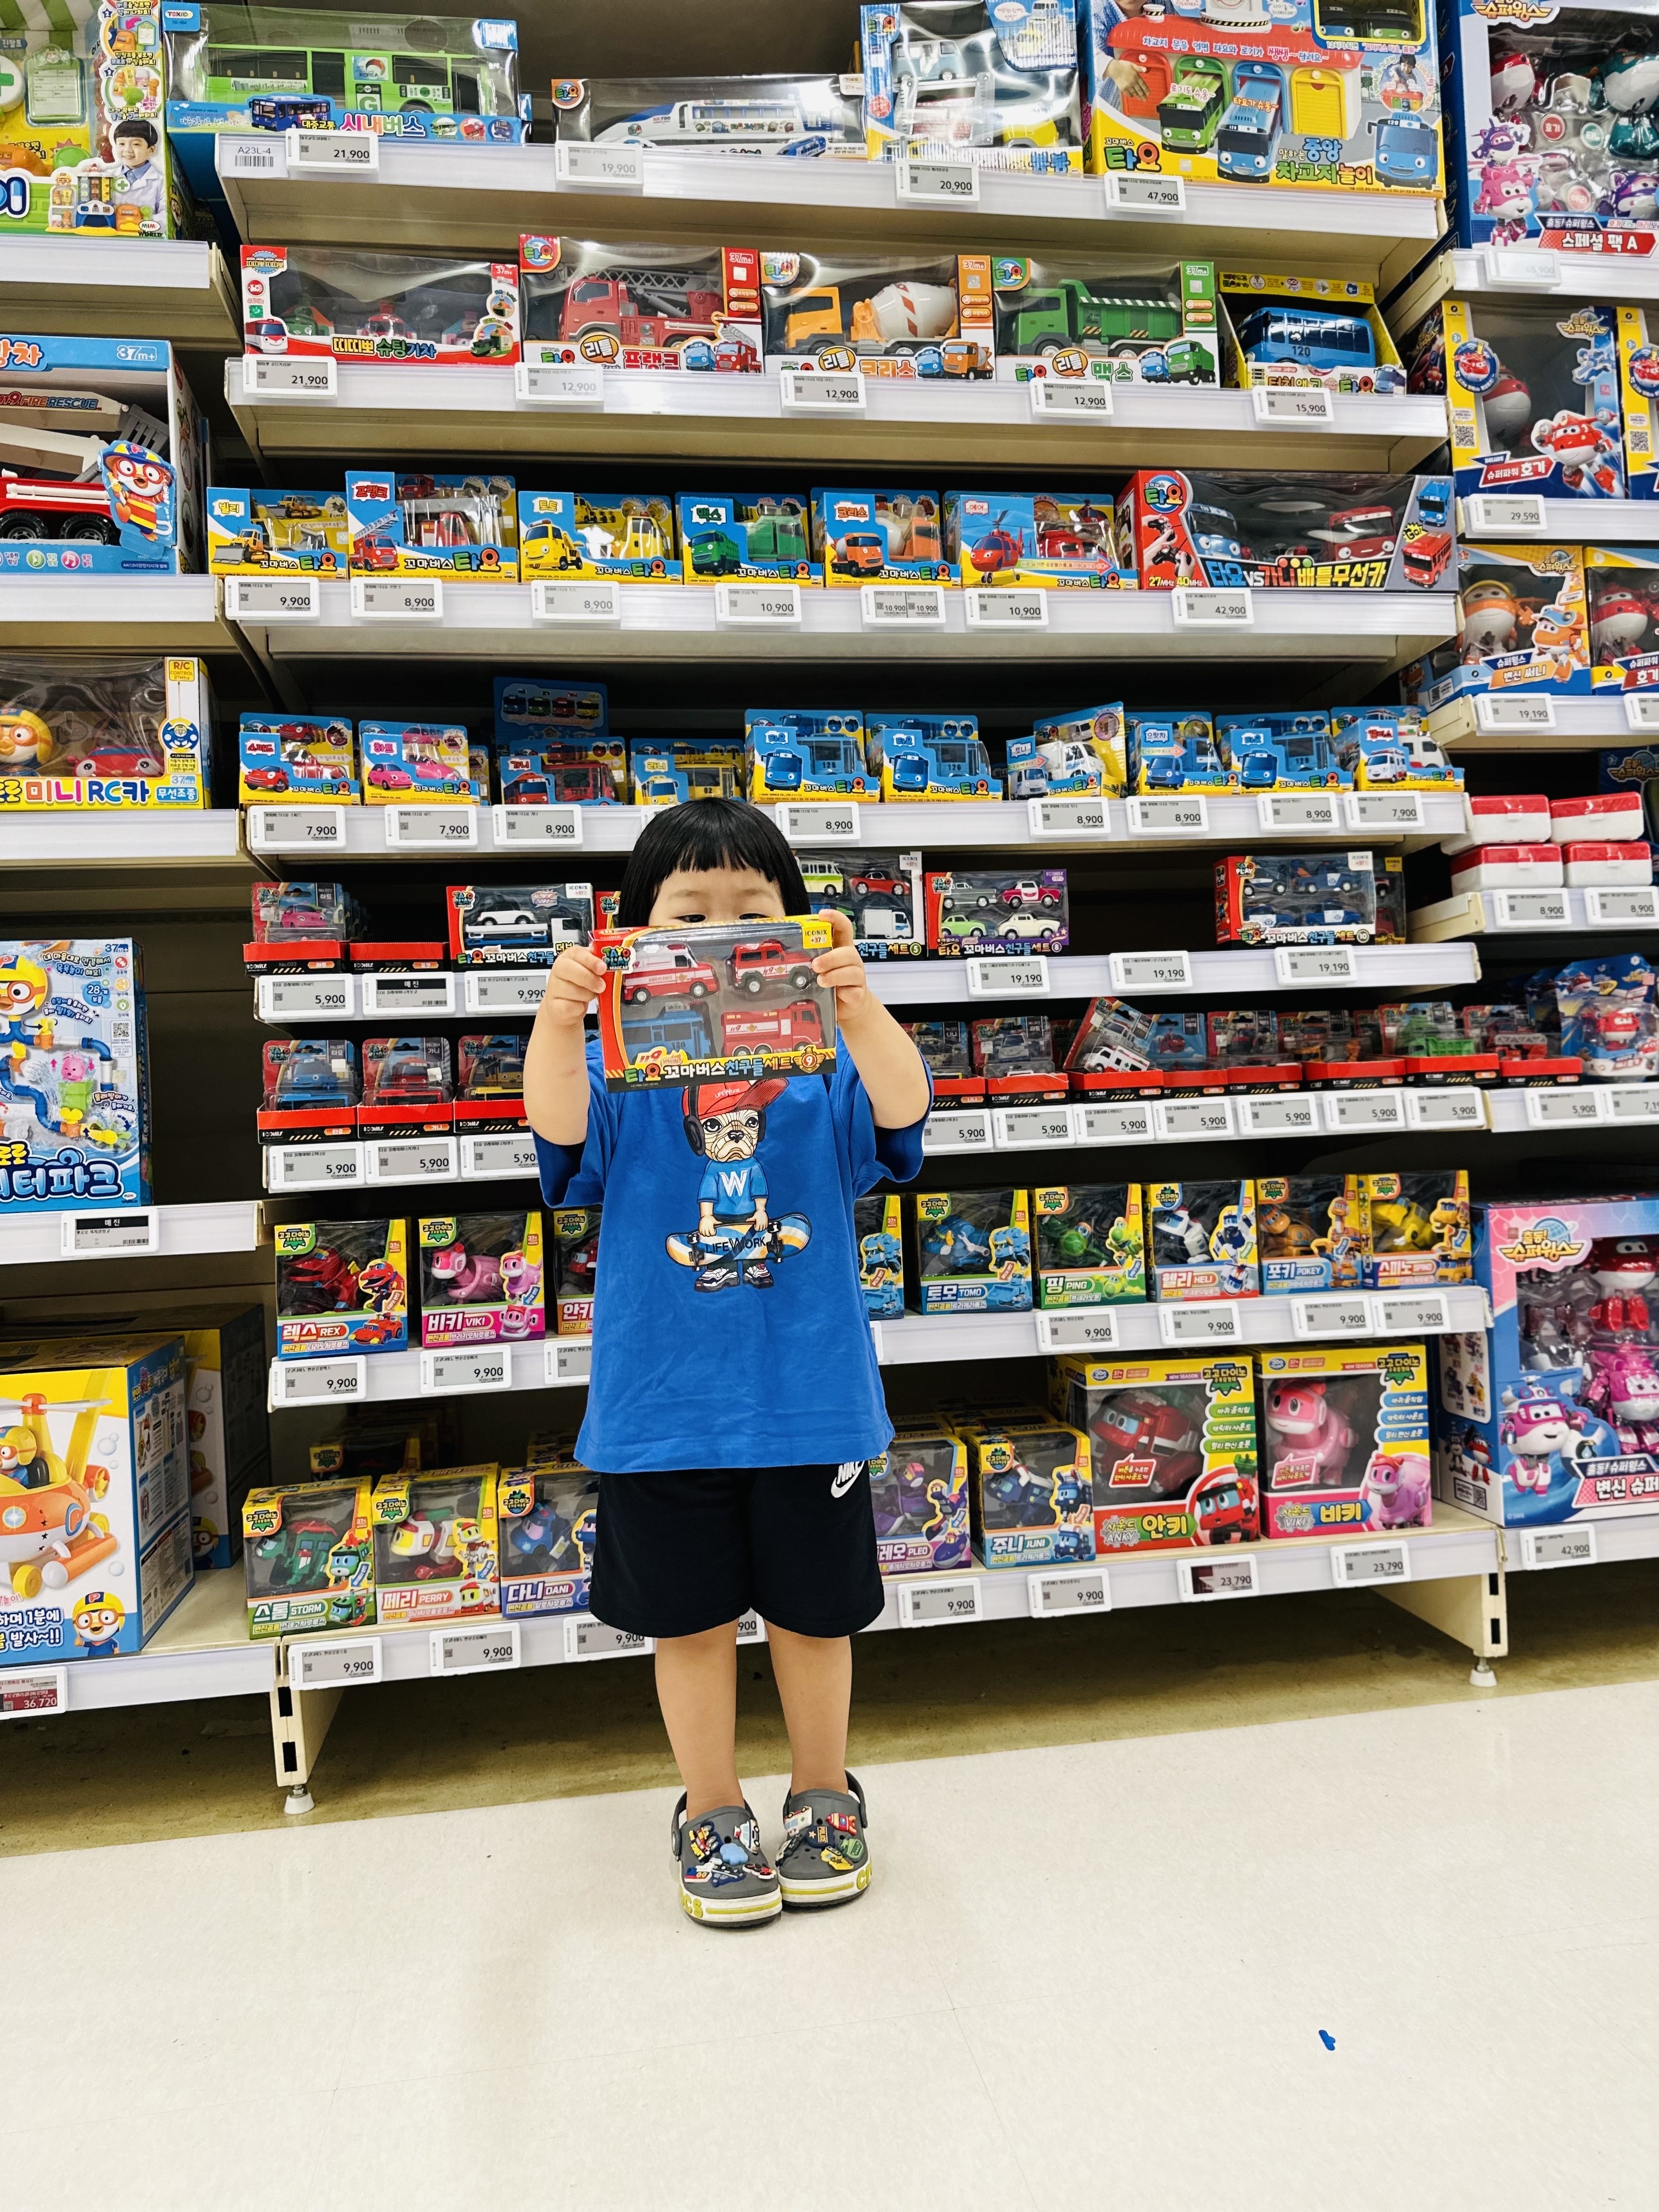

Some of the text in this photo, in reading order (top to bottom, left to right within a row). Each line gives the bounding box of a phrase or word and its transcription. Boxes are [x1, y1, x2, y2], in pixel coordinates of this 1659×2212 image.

[1142, 36, 1169, 48] 차고지
[1172, 39, 1189, 50] 문을
[1214, 43, 1237, 55] 타요와
[1240, 46, 1263, 58] 로기가
[359, 97, 377, 110] G
[302, 120, 335, 129] 대중교통
[340, 114, 426, 137] 시내버스
[1105, 138, 1134, 146] 꼬마버스
[334, 150, 369, 159] 21,900
[1278, 138, 1342, 162] 말하는 중앙
[1104, 142, 1162, 172] 타요
[602, 163, 635, 174] 19,900
[940, 180, 972, 191] 20,900
[1147, 191, 1178, 202] 47,900
[1562, 233, 1638, 252] 스페셜 팩 A
[332, 336, 374, 355] 띠띠뽀
[584, 336, 614, 356] 리틀
[1291, 346, 1311, 357] 120
[624, 351, 680, 371] 프랭크
[822, 351, 850, 370] 리틀
[1055, 353, 1083, 371] 리틀
[860, 360, 916, 378] 크리스
[1091, 362, 1132, 382] 맥스
[291, 375, 329, 385] 21,900
[561, 381, 596, 392] 12,900
[825, 390, 858, 400] 12,900
[48, 397, 99, 409] RESCUE
[1074, 397, 1105, 407] 12,900
[1296, 404, 1325, 414] 15,900
[1520, 459, 1545, 477] 호기
[1144, 484, 1183, 506] 타요
[1511, 512, 1539, 521] 29,590
[259, 552, 337, 571] 꼬마버스 타요
[404, 548, 501, 572] 꼬마버스 타요
[595, 560, 666, 578] 꼬마버스 타요
[737, 563, 811, 579] 꼬마버스 타요
[879, 564, 952, 582] 꼬마버스 타요
[1057, 574, 1120, 589] 꼬마버스 타요
[280, 596, 311, 607] 9,900
[404, 598, 434, 608] 8,900
[584, 600, 613, 611] 8,900
[761, 603, 793, 613] 10,900
[884, 605, 938, 613] 10,900 10,900
[1009, 607, 1041, 617] 10,900
[1215, 606, 1246, 616] 42,900
[173, 661, 190, 670] R/C
[1503, 665, 1546, 682] 변신 써니
[1519, 710, 1548, 718] 19,190
[292, 782, 351, 795] 꼬마버스 타요
[415, 780, 471, 794] 꼬마버스 타요
[804, 777, 866, 794] 꼬마버스 타요
[25, 780, 149, 804] 미니 RC카
[158, 788, 196, 802] 무선조종
[1175, 813, 1200, 822] 8,900
[1306, 810, 1331, 819] 8,900
[1391, 808, 1417, 817] 7,900
[826, 821, 853, 831] 8,900
[1077, 815, 1103, 825] 8,900
[307, 826, 336, 837] 7,900
[439, 826, 469, 836] 7,900
[546, 825, 574, 834] 8,900
[1539, 906, 1564, 915] 8,900
[1630, 904, 1654, 913] 8,900
[53, 952, 80, 964] 마음대로
[457, 950, 483, 964] 타요
[1153, 968, 1184, 979] 19,190
[1319, 962, 1349, 973] 19,190
[1011, 973, 1042, 984] 19,190
[88, 985, 100, 994] 28
[315, 995, 345, 1005] 5,900
[637, 1051, 660, 1064] 119
[624, 1063, 661, 1084] 타요
[805, 1055, 813, 1067] 9
[1372, 1108, 1397, 1118] 5,900
[1452, 1106, 1476, 1116] 5,900
[1572, 1105, 1596, 1114] 5,900
[1201, 1116, 1226, 1126] 5,900
[1285, 1112, 1311, 1122] 5,900
[1041, 1124, 1068, 1135] 5,900
[1120, 1119, 1146, 1130] 5,900
[959, 1128, 985, 1139] 5,900
[326, 1163, 357, 1174] 5,900
[419, 1158, 449, 1169] 5,900
[721, 1170, 748, 1197] W
[104, 1219, 121, 1227] 매진
[1522, 1230, 1547, 1244] 출동!
[1498, 1241, 1584, 1261] 슈퍼윙스
[1267, 1263, 1322, 1279] 포키 POKEY
[1046, 1277, 1088, 1294] 핑 PING
[1161, 1272, 1213, 1289] 헬리 HELI
[927, 1284, 982, 1300] 토모 TOMO
[427, 1312, 486, 1331] 비키 VIKI
[1340, 1314, 1365, 1325] 9,900
[1418, 1312, 1442, 1323] 9,900
[282, 1323, 341, 1341] 렉스 REX
[1085, 1328, 1111, 1338] 9,900
[1207, 1322, 1234, 1332] 9,900
[474, 1368, 504, 1379] 9,900
[327, 1379, 358, 1390] 9,900
[838, 1460, 862, 1485] NIKE
[1595, 1481, 1628, 1499] 변신
[1283, 1500, 1362, 1528] VIKI 비키
[1104, 1514, 1188, 1545] ANKY 안키
[992, 1536, 1046, 1553] 주니 JUNI
[1561, 1543, 1589, 1555] 42,900
[907, 1546, 929, 1557] PLEO
[1373, 1561, 1403, 1573] 23,790
[1220, 1576, 1251, 1588] 23,790
[506, 1582, 569, 1602] 다니 DANI
[1077, 1590, 1103, 1602] 9,900
[382, 1589, 449, 1611] 페리 PERRY
[947, 1600, 974, 1611] 9,900
[26, 1609, 60, 1625] 1분에
[253, 1600, 323, 1622] 스톰 STORM
[10, 1629, 59, 1646] 발사~!!
[483, 1646, 512, 1658] 9,900
[343, 1661, 374, 1673] 9,900
[24, 1697, 57, 1709] 36,720
